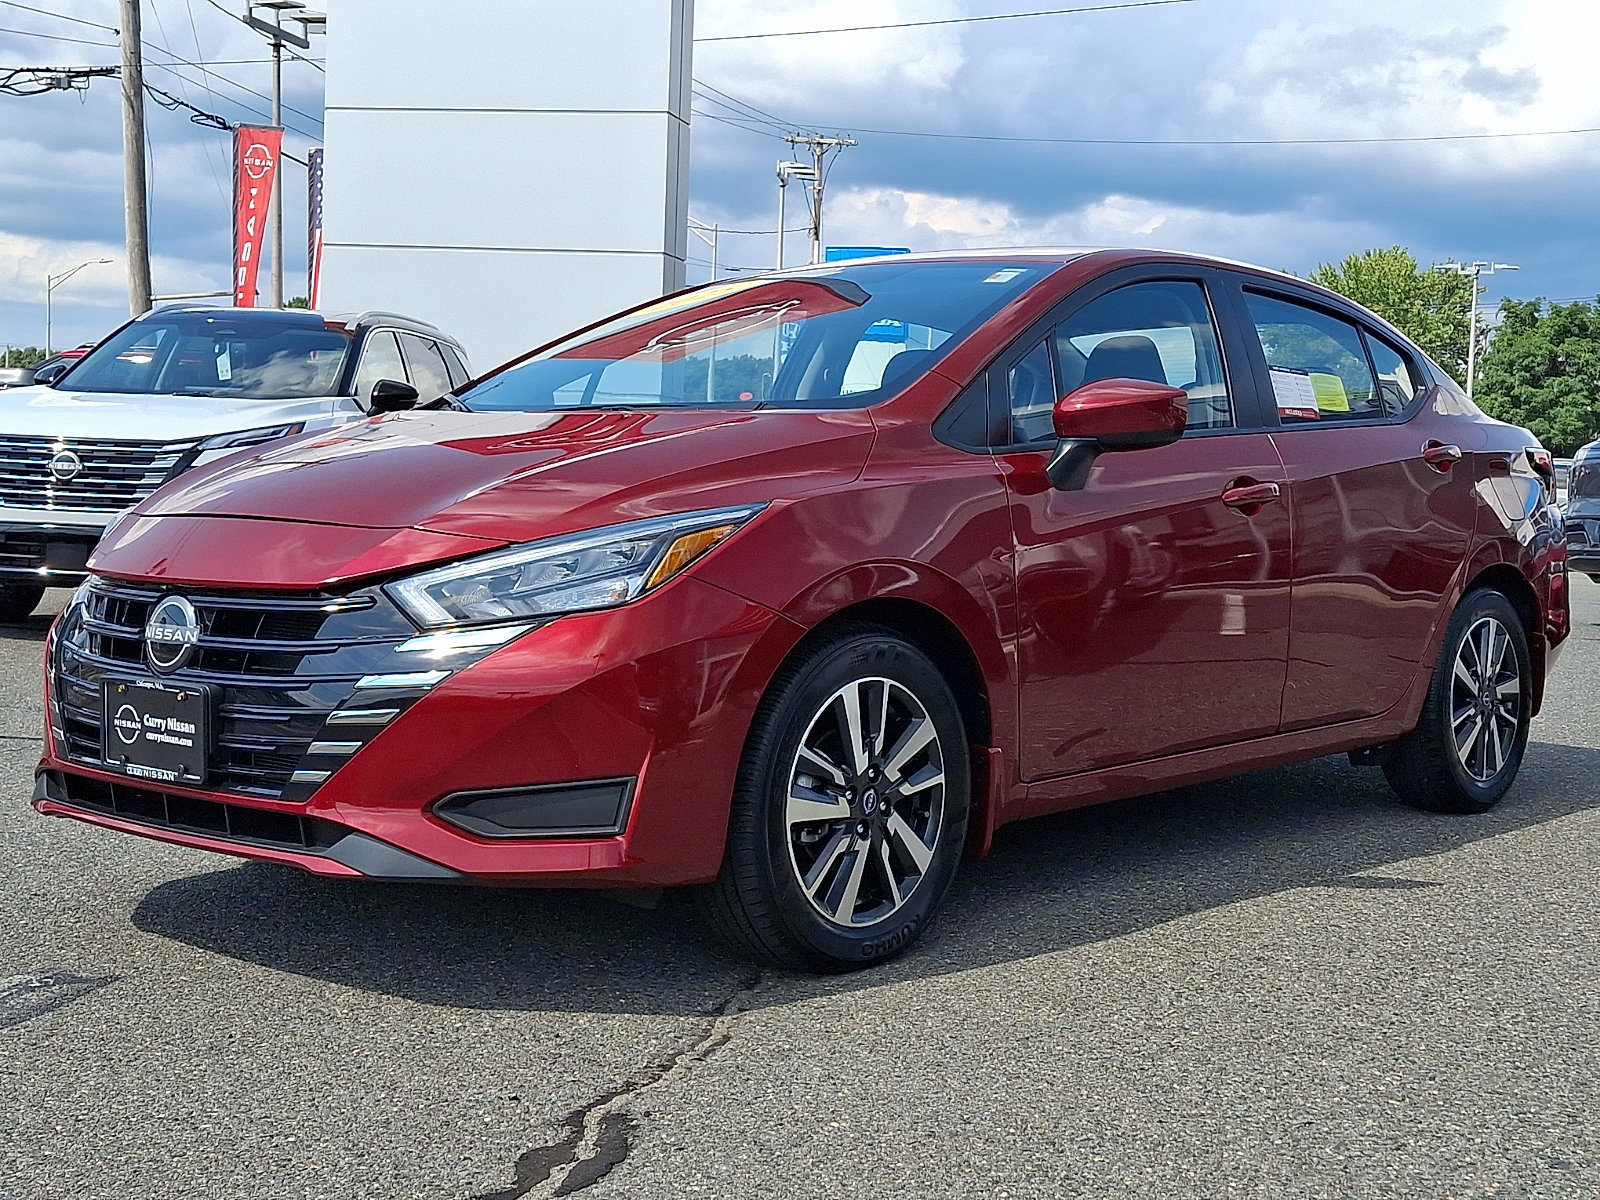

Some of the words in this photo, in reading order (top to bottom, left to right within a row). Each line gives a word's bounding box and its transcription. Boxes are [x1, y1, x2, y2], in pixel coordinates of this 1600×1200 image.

[48, 462, 83, 470] NISSAN
[145, 626, 198, 642] NISSAN
[113, 718, 142, 730] NISSAN
[143, 713, 167, 732] Curry
[167, 717, 196, 734] Nissan
[145, 732, 193, 747] currynissan.com
[143, 769, 175, 781] NISSAN
